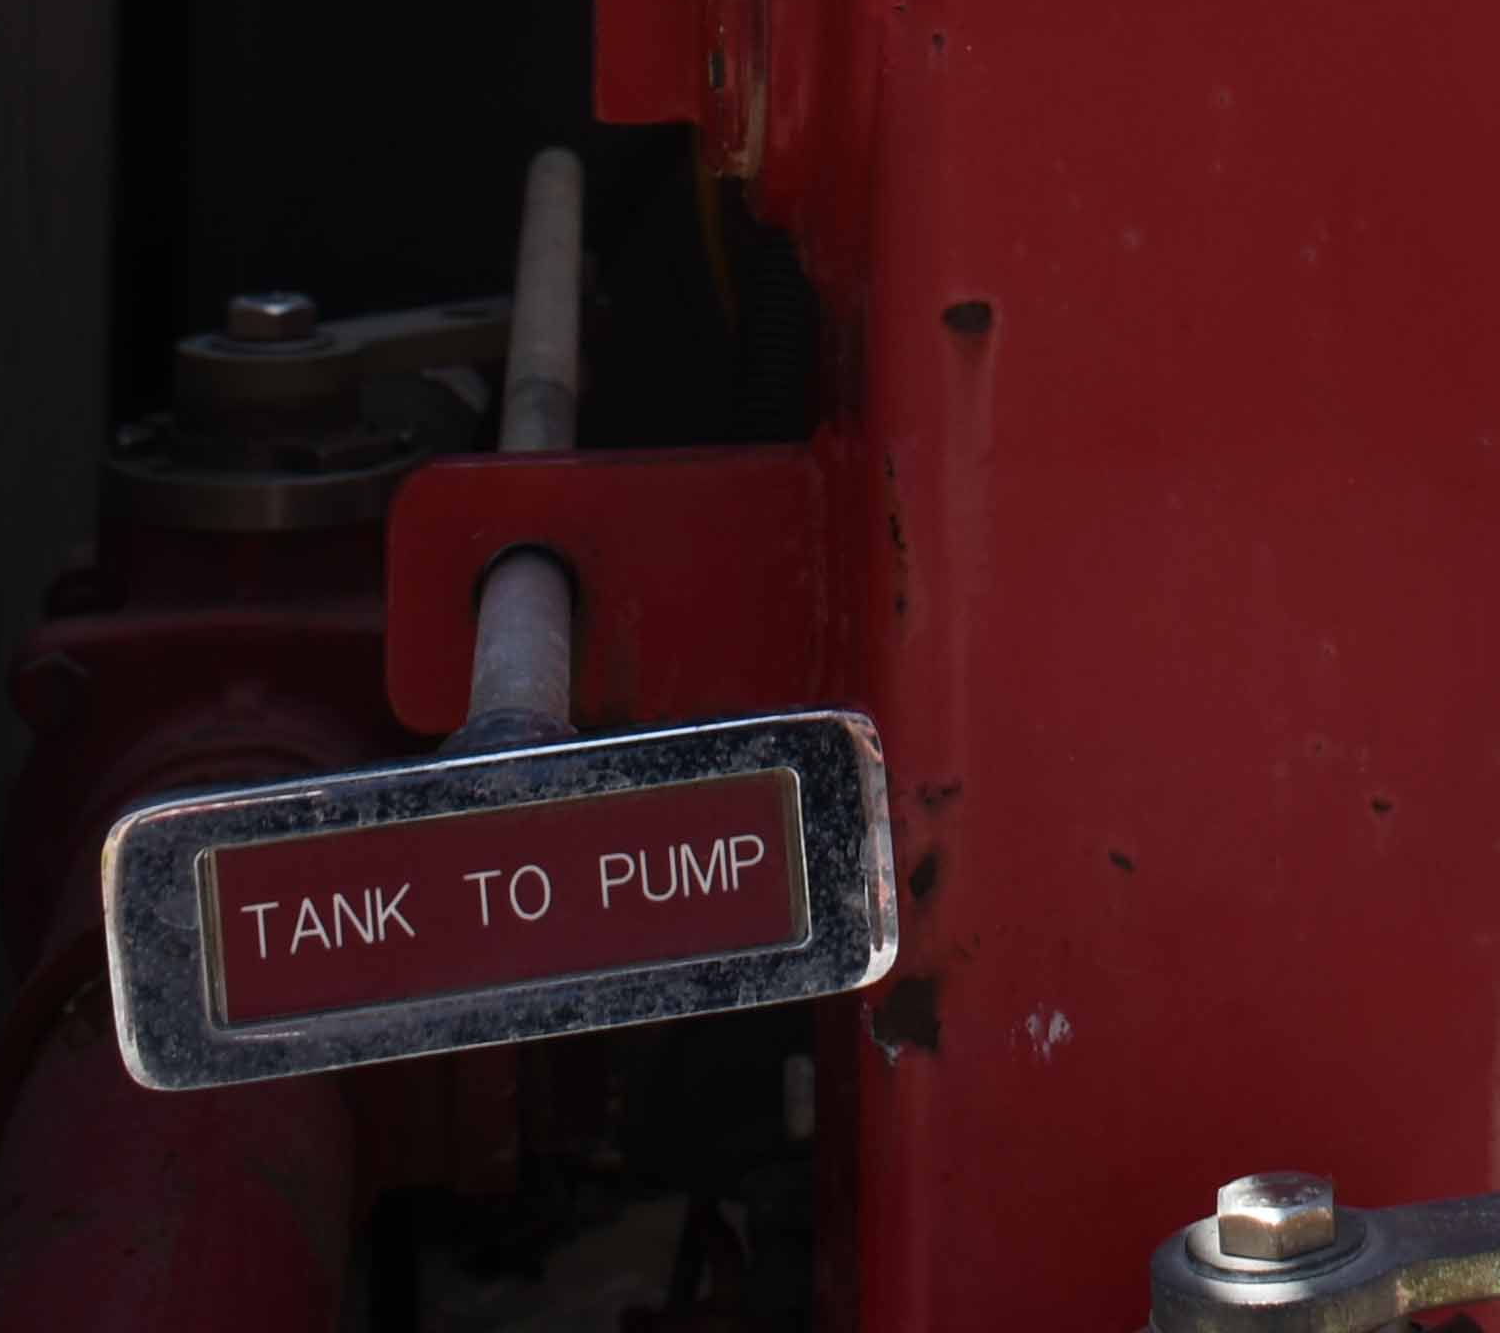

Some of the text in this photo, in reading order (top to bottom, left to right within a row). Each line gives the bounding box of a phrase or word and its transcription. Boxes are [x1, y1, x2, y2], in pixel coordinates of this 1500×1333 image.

[240, 834, 766, 960] TANK TO PUMP
